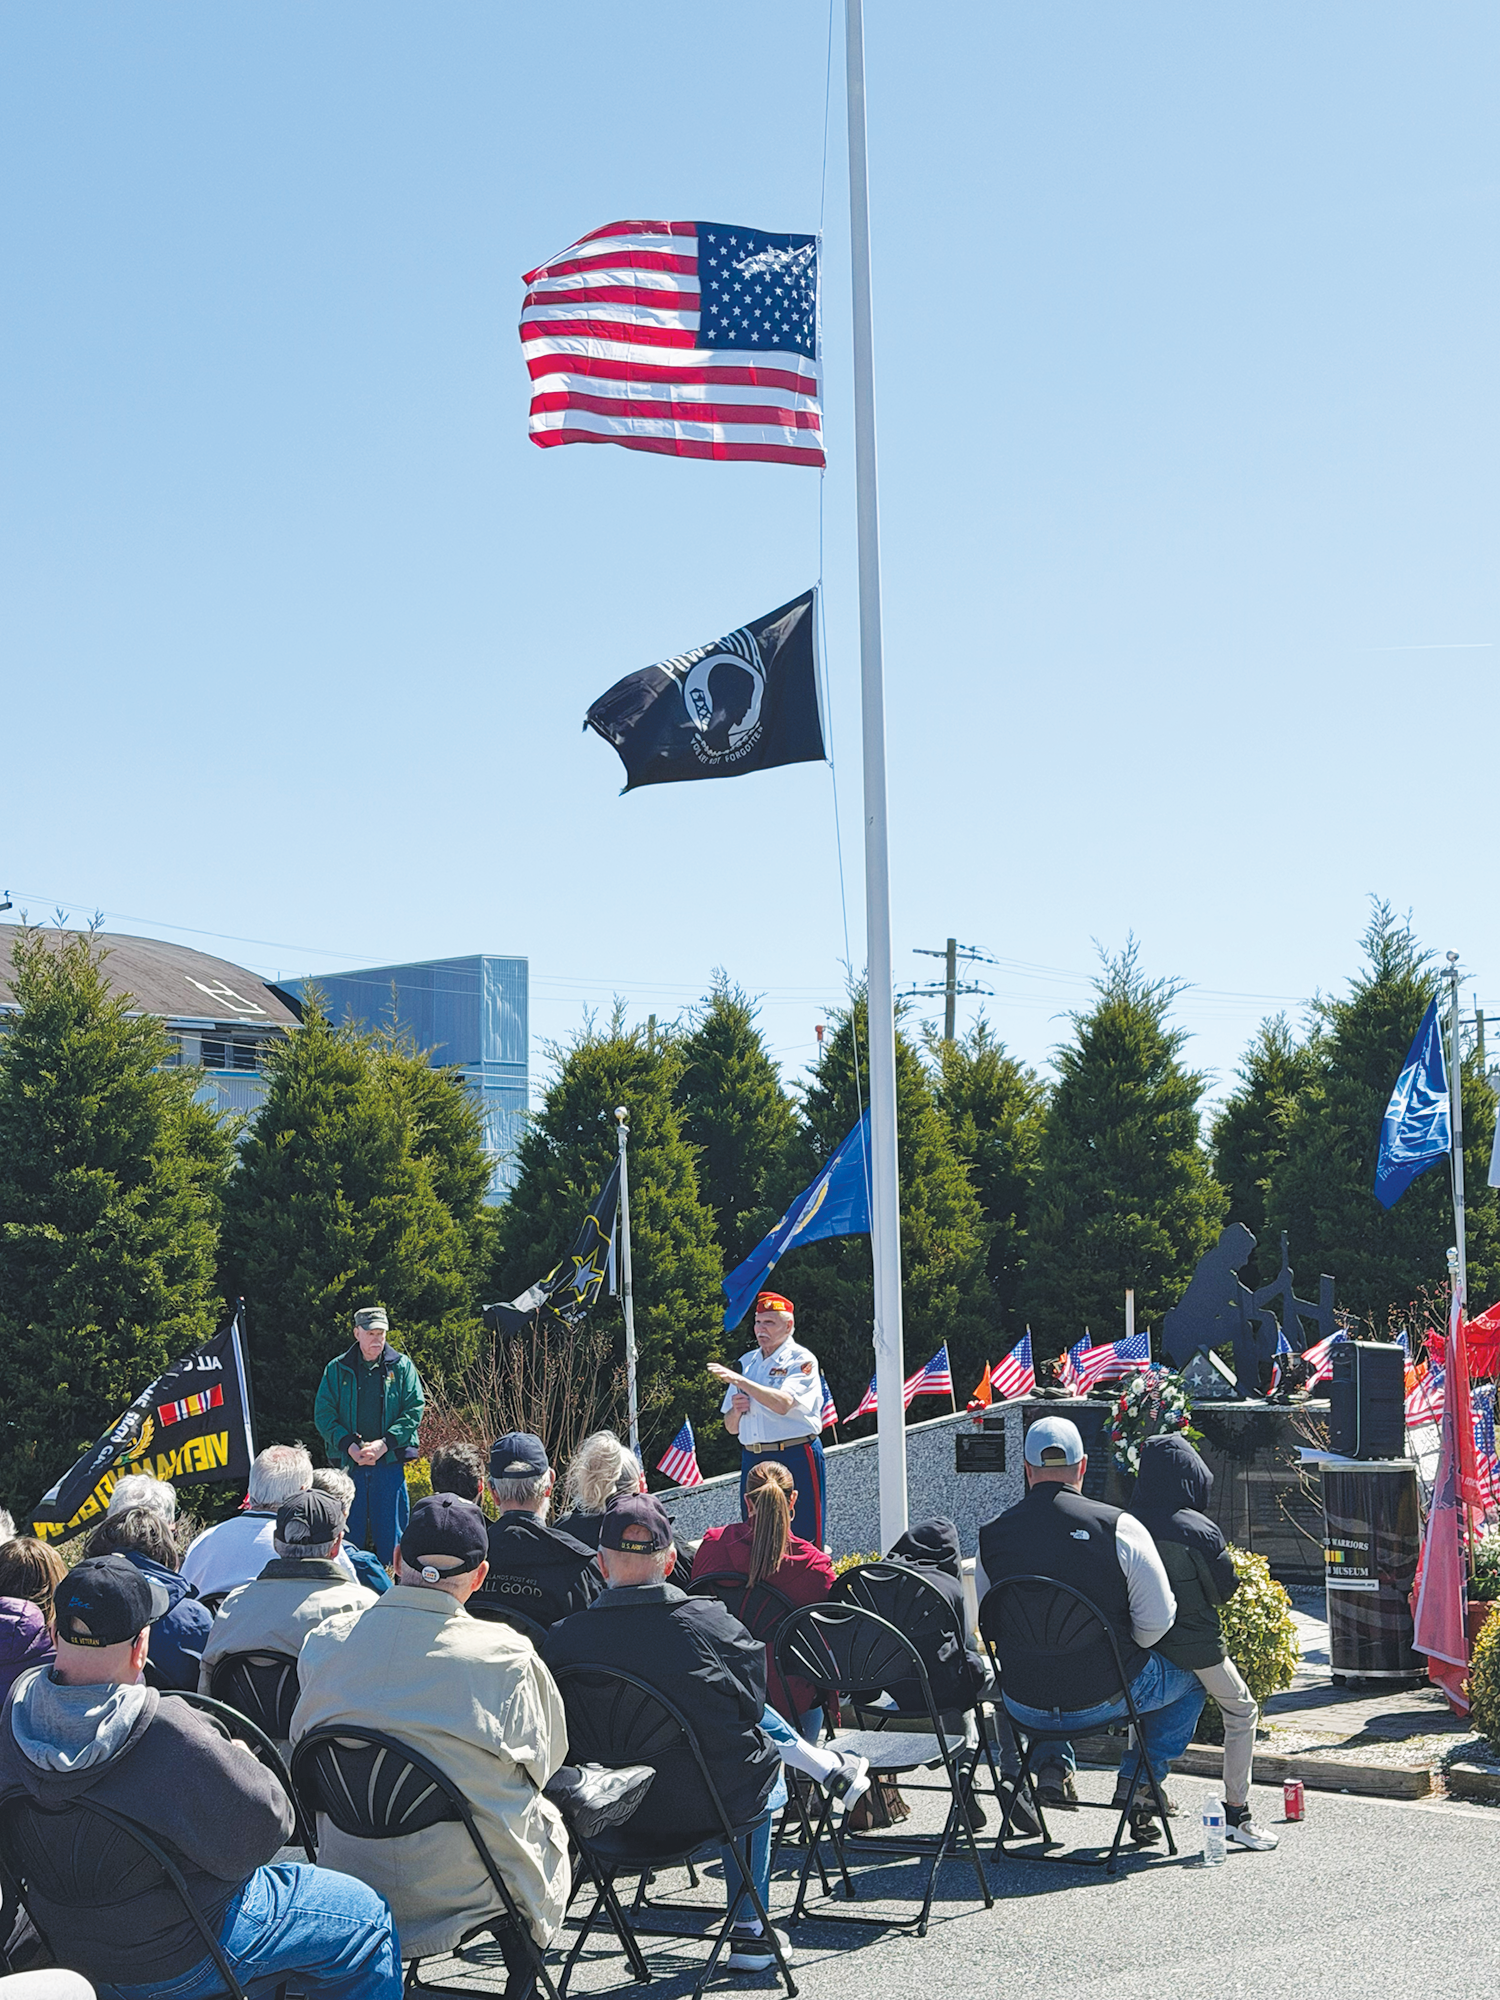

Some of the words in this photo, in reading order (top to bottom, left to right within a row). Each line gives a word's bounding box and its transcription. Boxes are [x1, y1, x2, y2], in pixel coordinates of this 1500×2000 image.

[1331, 1538, 1370, 1551] WARRIORS
[1332, 1566, 1369, 1576] MUSEUM
[500, 1582, 543, 1598] GOOD
